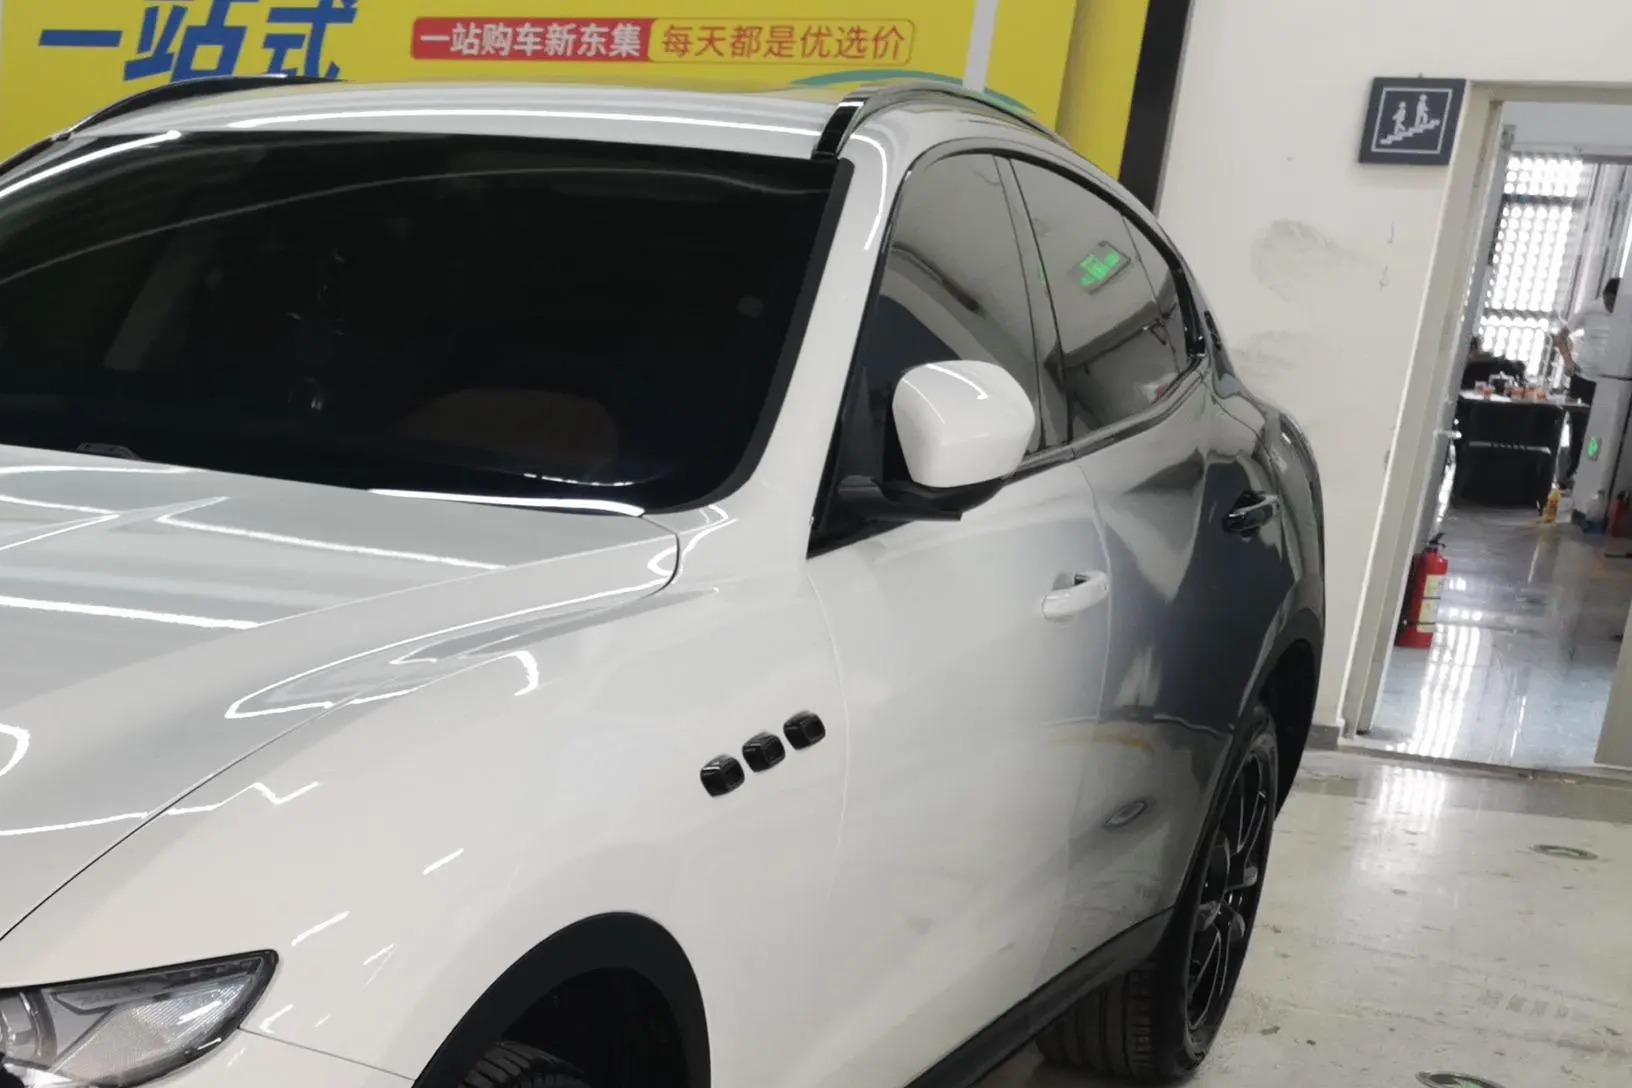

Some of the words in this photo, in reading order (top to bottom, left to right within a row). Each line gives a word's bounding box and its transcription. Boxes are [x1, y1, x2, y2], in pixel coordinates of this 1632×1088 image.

[39, 0, 358, 81] 一站式
[420, 22, 642, 58] 一站购车新东集
[661, 24, 905, 61] 每天都是优选价
